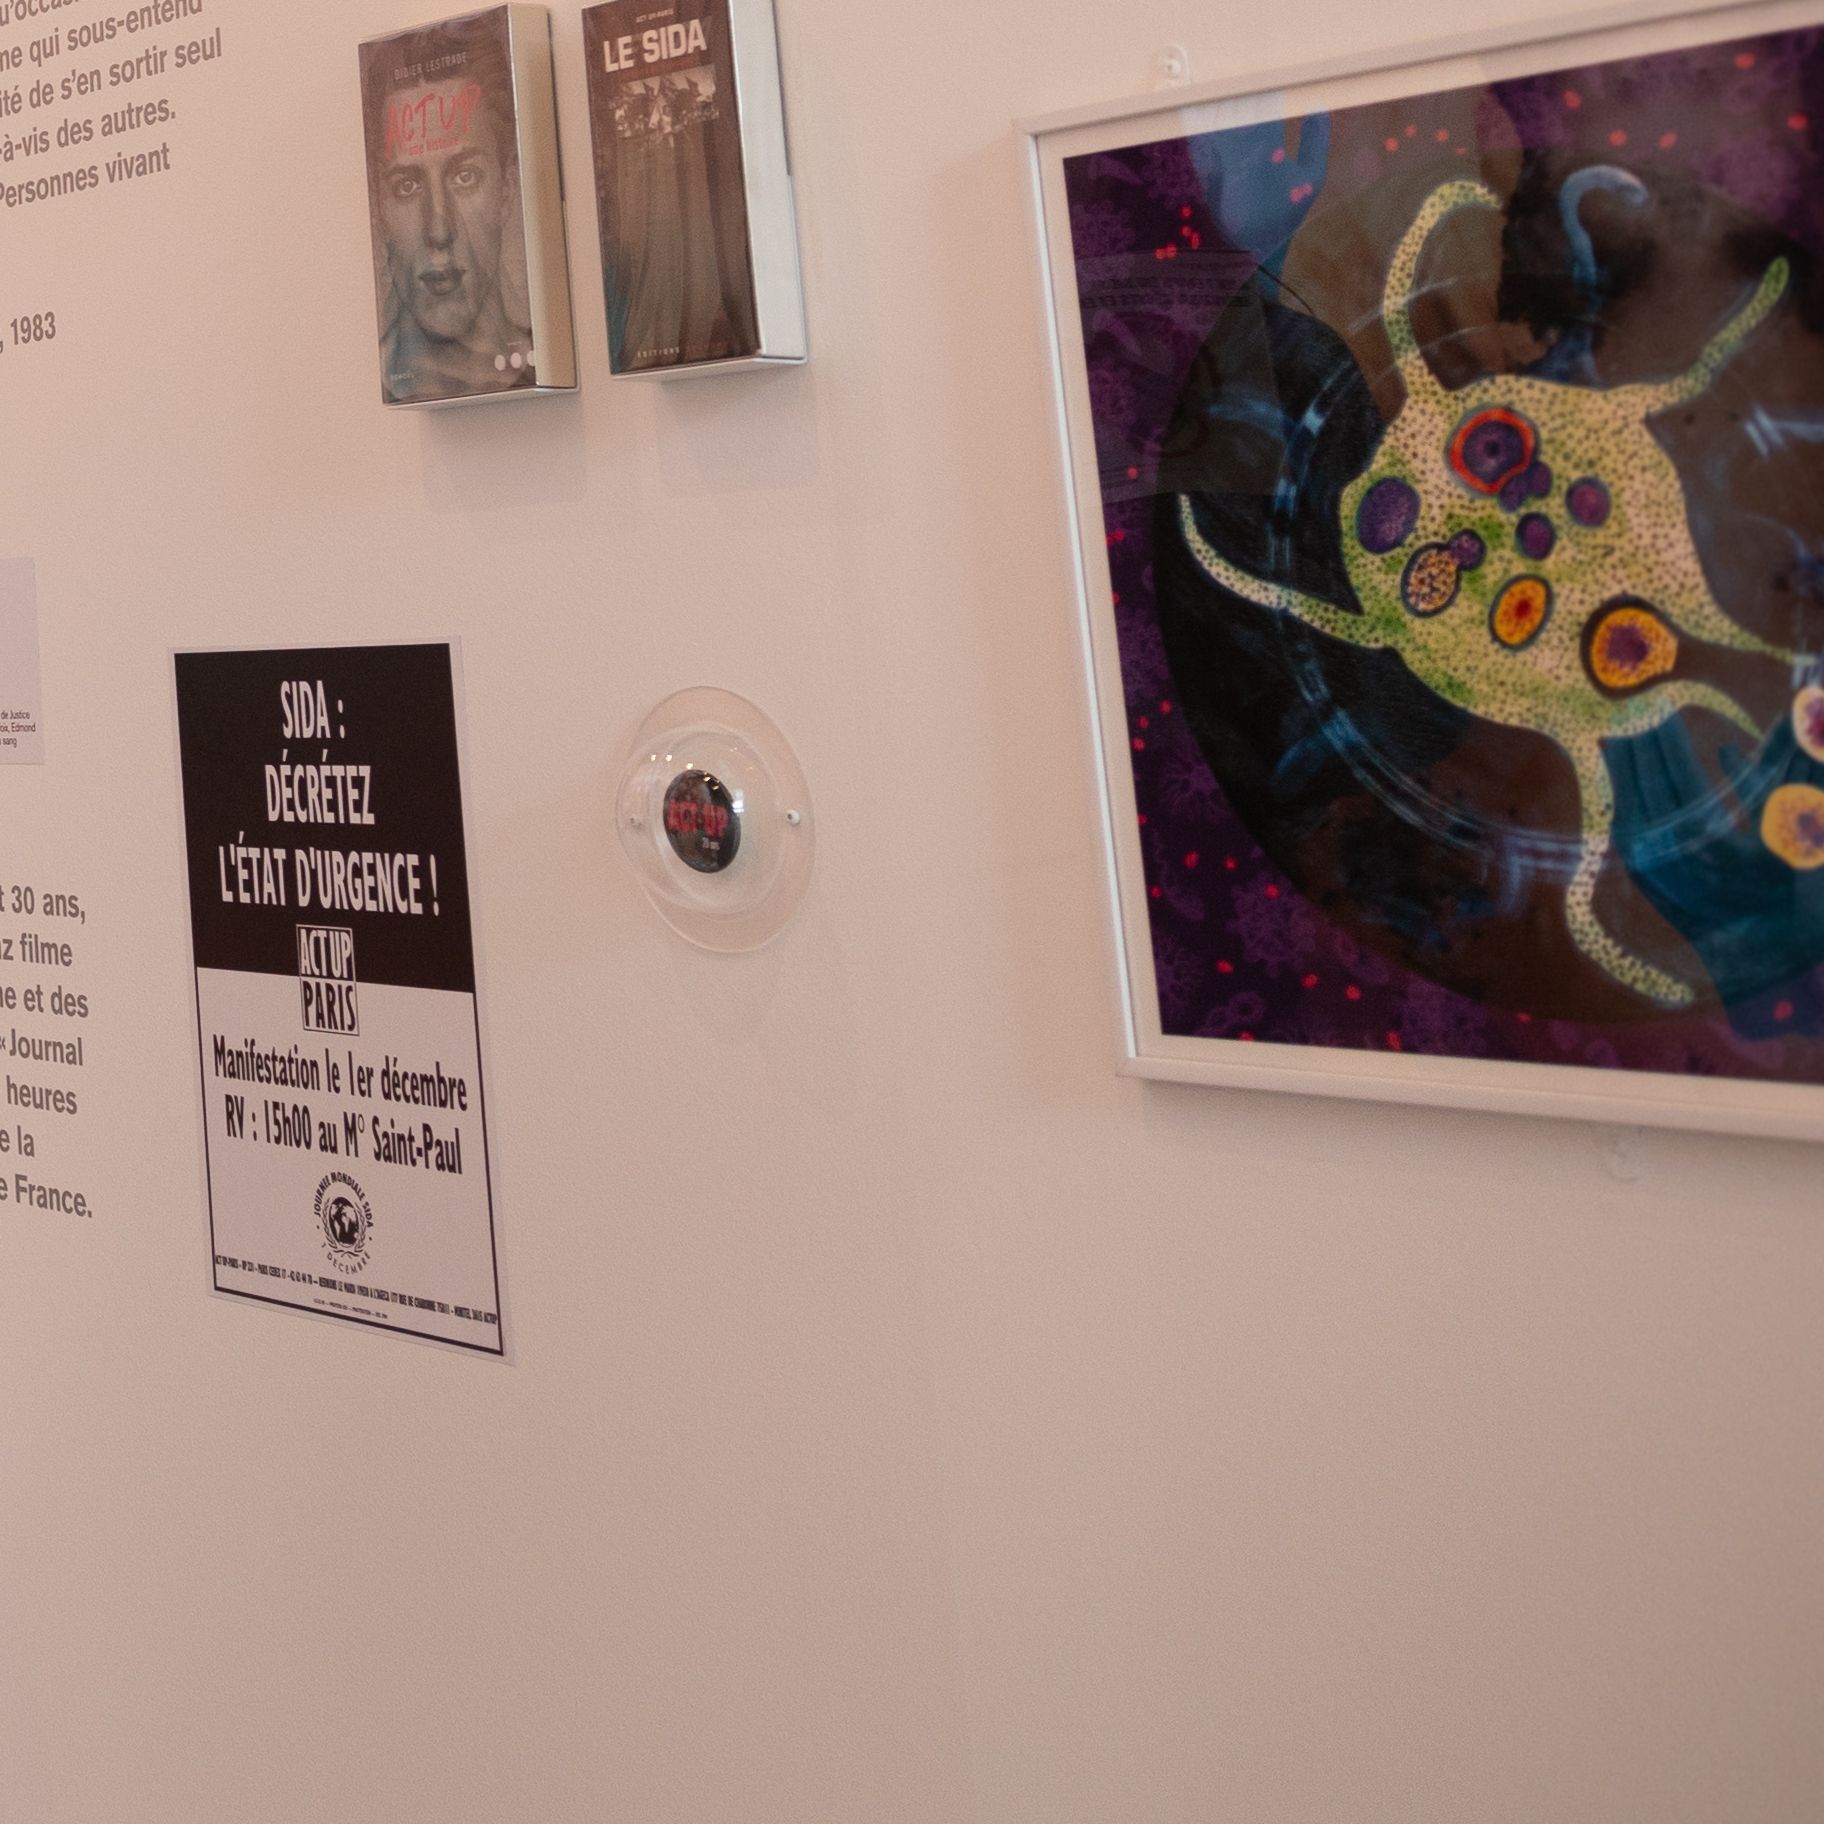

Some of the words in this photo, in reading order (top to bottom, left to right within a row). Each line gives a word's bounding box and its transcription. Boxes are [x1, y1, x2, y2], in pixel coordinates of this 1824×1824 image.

[28, 79, 55, 110] de
[108, 45, 168, 87] sortir
[174, 26, 222, 69] seul
[394, 62, 423, 81] DIDIER
[425, 51, 467, 74] LESTRADE
[603, 35, 635, 73] LE
[642, 18, 708, 64] SIDA
[384, 92, 436, 161] ACT
[439, 79, 481, 136] UP
[104, 141, 171, 184] vivant
[10, 311, 56, 346] 1983
[9, 710, 31, 721] Justice
[280, 679, 332, 739] SIDA
[264, 748, 376, 825] DÉCRÉTEZ
[218, 830, 287, 906] L'ÉTAT
[294, 847, 424, 916] D'URGENCE
[11, 884, 35, 915] 30
[42, 893, 86, 925] ans,
[19, 932, 73, 968] filme
[299, 928, 328, 978] ACT
[328, 930, 352, 979] UP
[301, 980, 356, 1032] PARIS
[213, 1033, 321, 1092] Manifestation
[325, 1047, 341, 1094] le
[348, 1050, 374, 1099] 1er
[380, 1054, 468, 1112] décembre
[224, 1093, 245, 1140] RV
[263, 1098, 313, 1151] 15h00
[318, 1119, 339, 1155] au
[371, 1114, 463, 1175] Saint-Paul
[14, 1173, 93, 1219] France.
[330, 1171, 366, 1202] MONDIALE
[362, 1201, 374, 1228] SIDA
